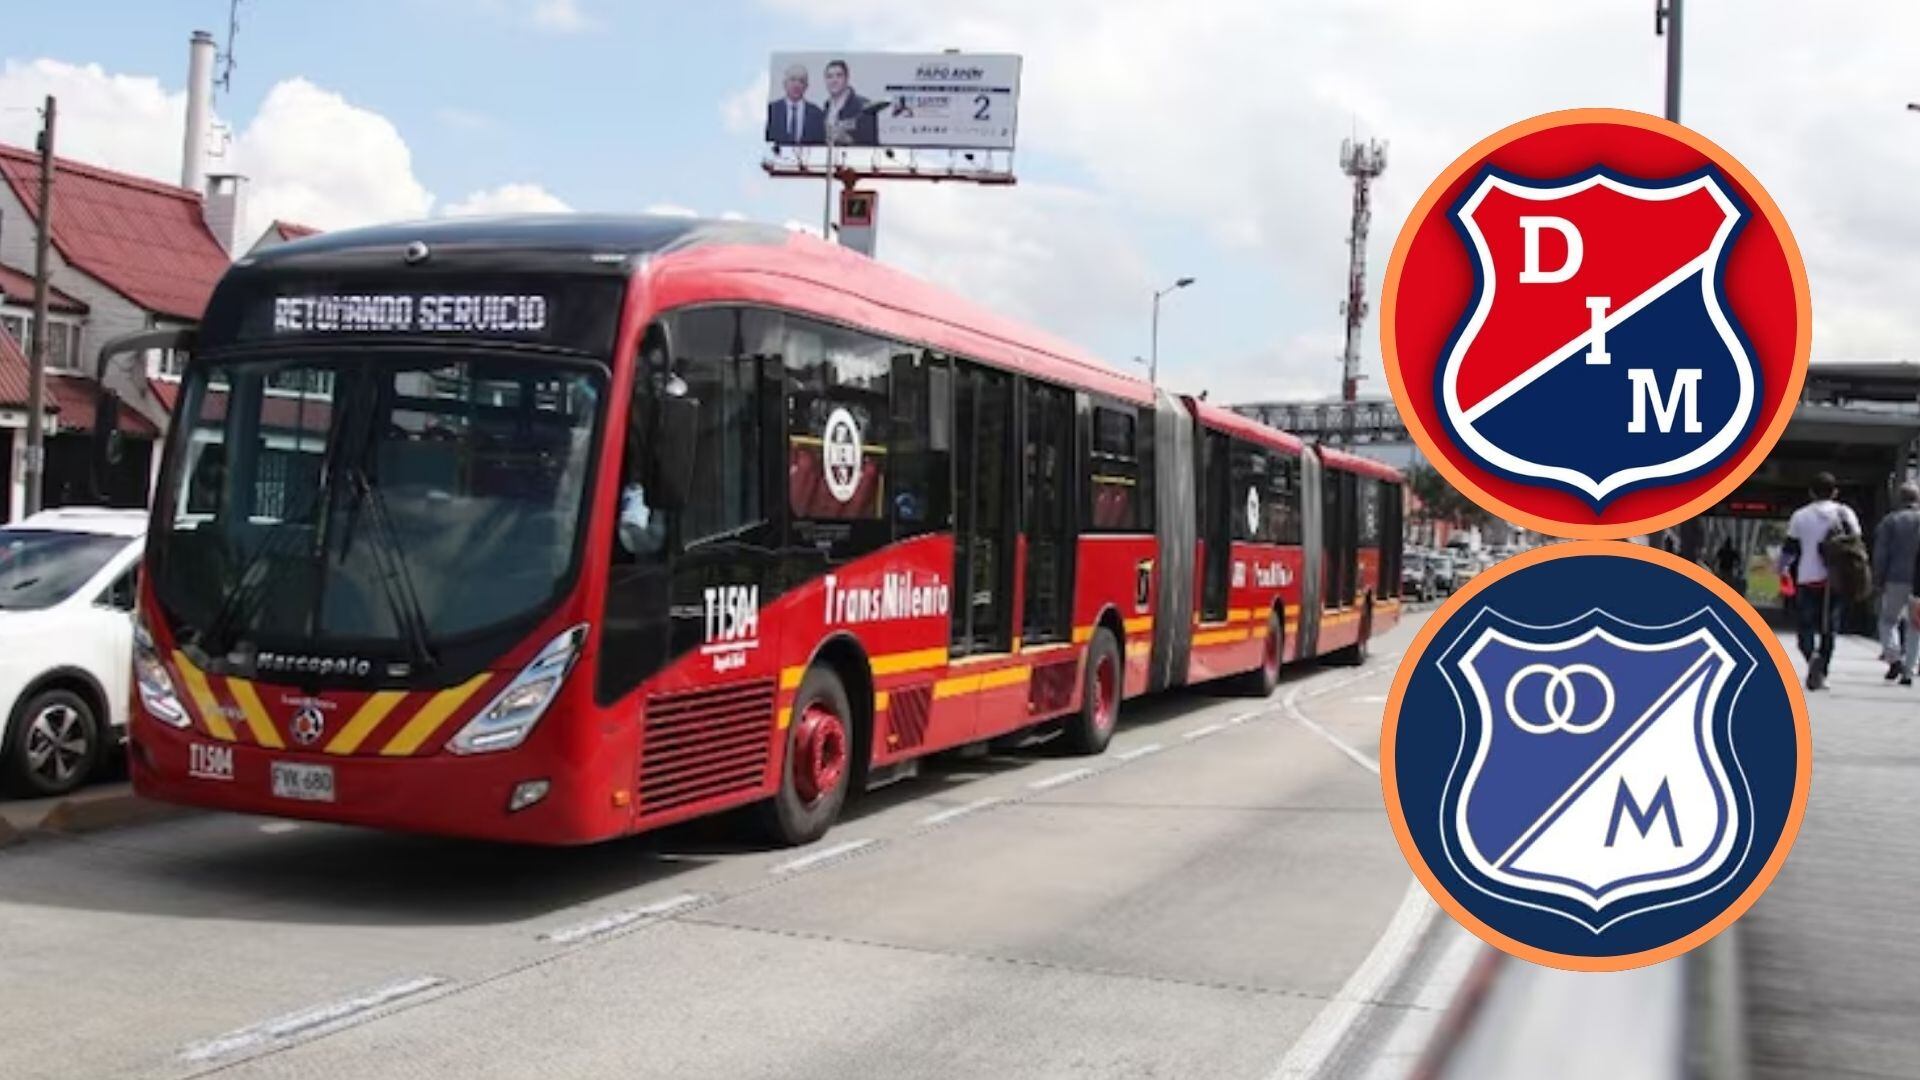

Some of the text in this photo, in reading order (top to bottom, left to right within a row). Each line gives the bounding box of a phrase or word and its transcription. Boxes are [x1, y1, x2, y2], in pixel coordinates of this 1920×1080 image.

[973, 95, 991, 121] 2
[418, 295, 546, 331] SERVICIO
[704, 584, 759, 643] T1504
[824, 570, 950, 626] TransMilenio
[256, 651, 372, 677] Marcopolo
[189, 743, 233, 775] T1504
